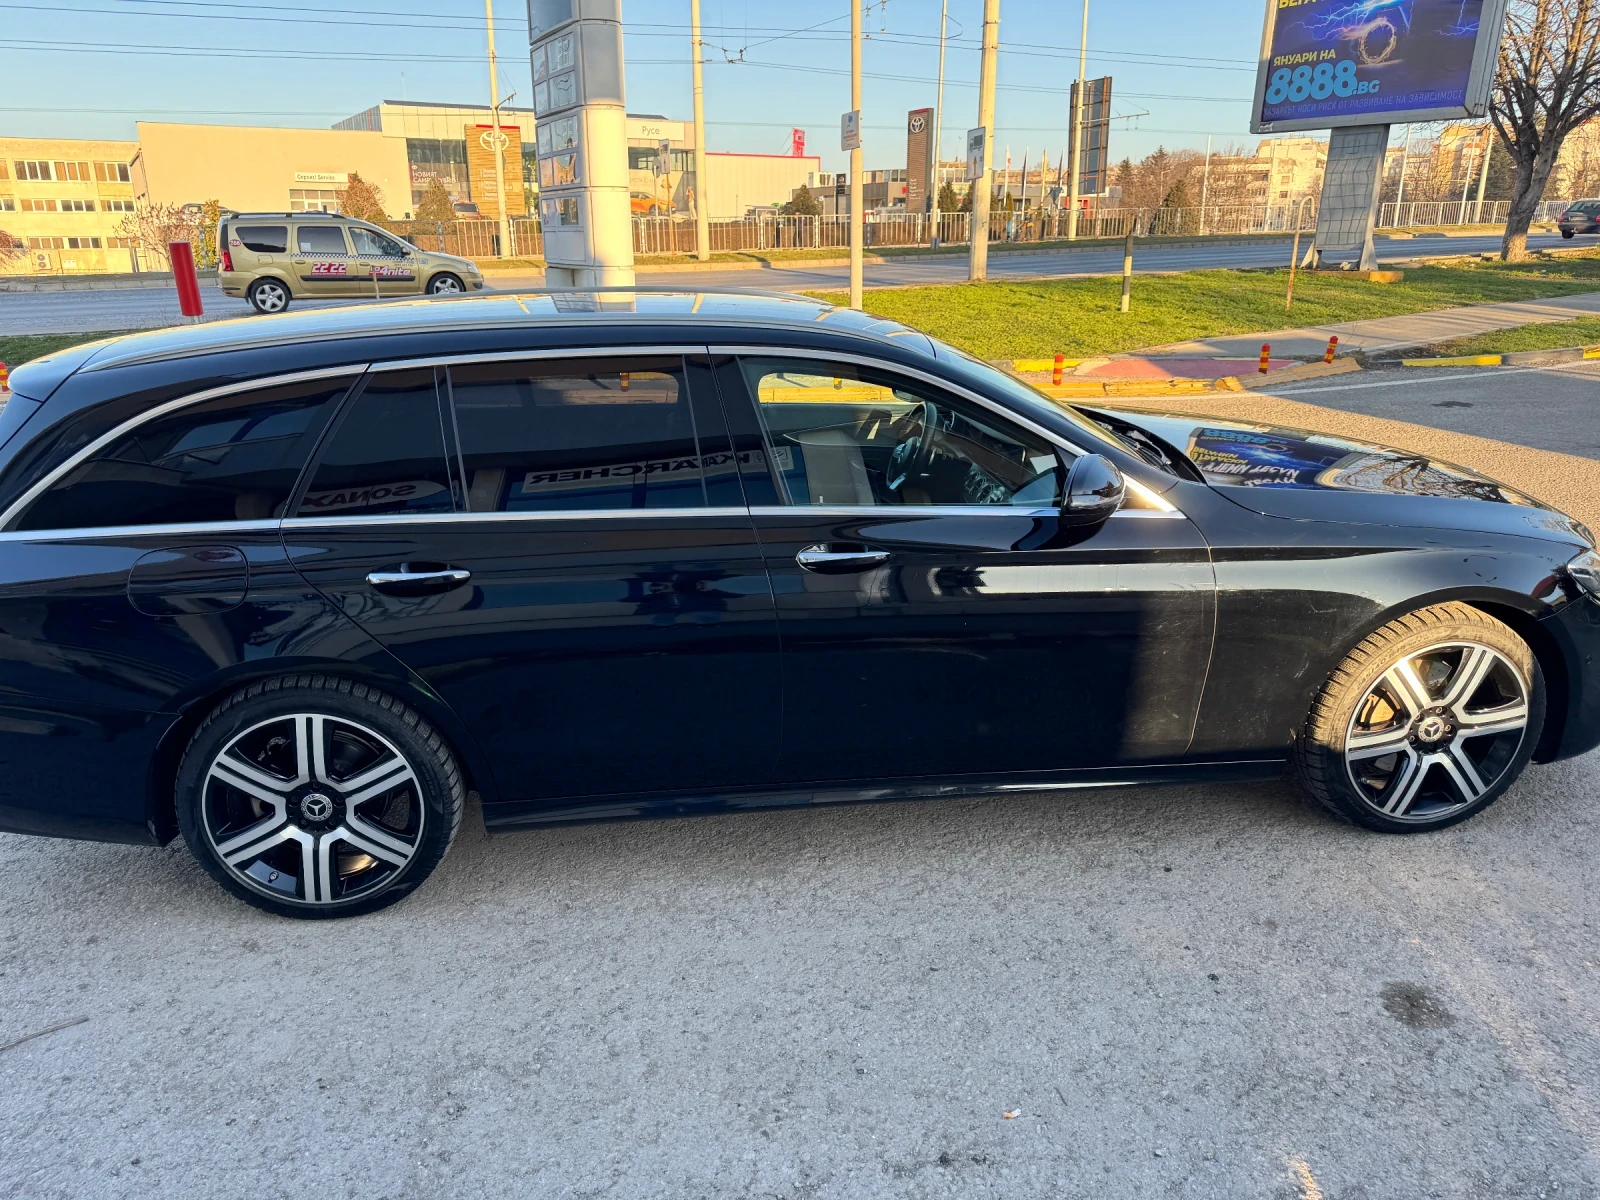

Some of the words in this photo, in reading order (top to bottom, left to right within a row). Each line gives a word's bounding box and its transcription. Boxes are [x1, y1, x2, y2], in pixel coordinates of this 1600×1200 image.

[1273, 50, 1317, 66] ЯНУАРИ
[1320, 48, 1336, 60] НА
[1297, 102, 1317, 114] НОСИ
[1318, 100, 1337, 112] РИСК
[1338, 98, 1348, 109] ОТ
[1350, 95, 1394, 108] РАЗВИВАНЕ
[1395, 95, 1407, 105] НА
[1408, 89, 1464, 104] ЗАВИСИМОСТ
